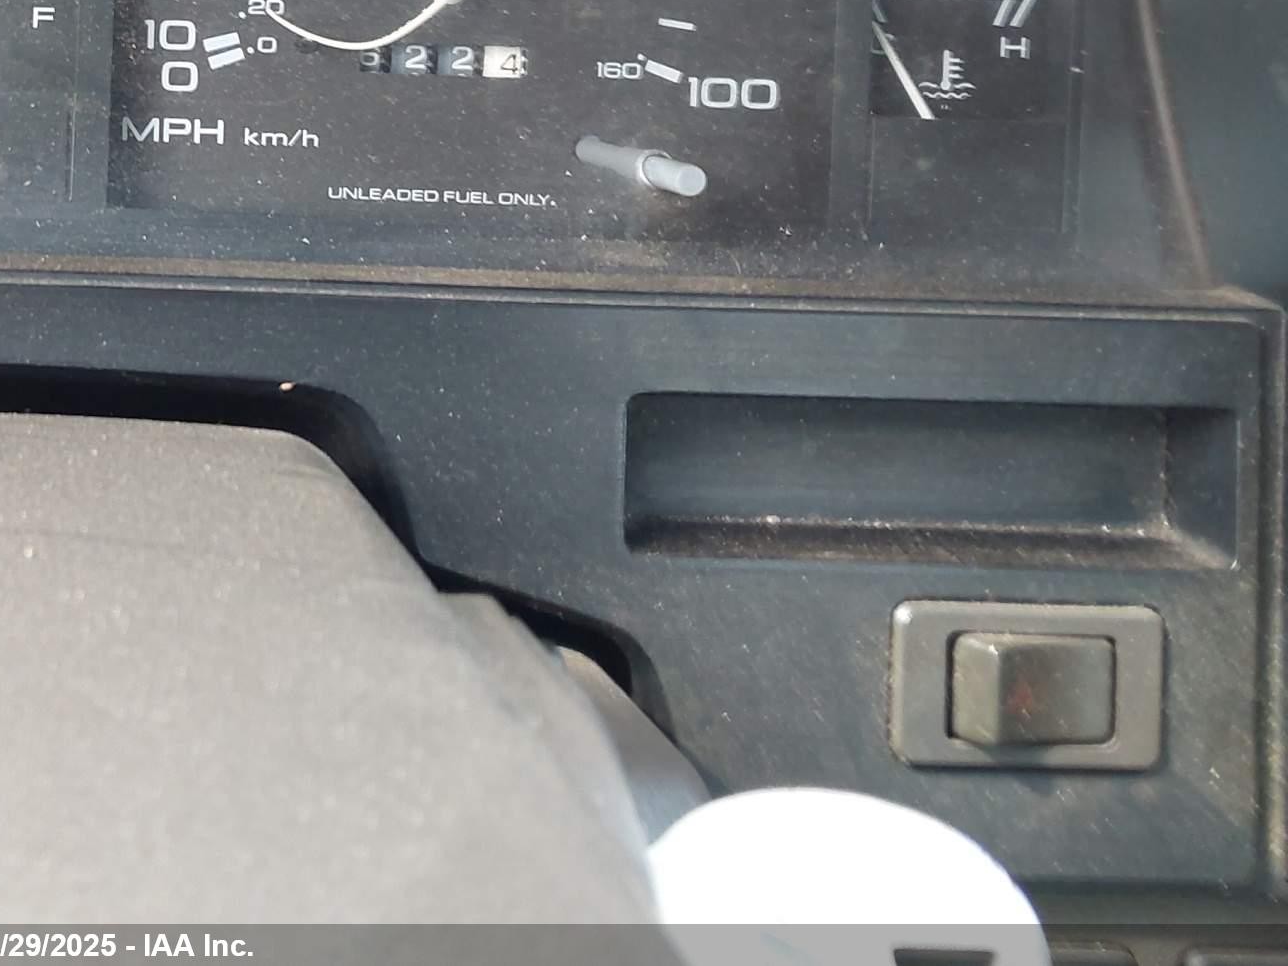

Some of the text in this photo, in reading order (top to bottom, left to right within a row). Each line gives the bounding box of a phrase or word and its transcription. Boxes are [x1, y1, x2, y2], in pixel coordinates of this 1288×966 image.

[32, 7, 55, 29] F
[144, 19, 197, 51] 10
[257, 36, 277, 54] 0
[999, 37, 1031, 60] H
[161, 60, 199, 92] 0
[596, 60, 644, 80] 160
[688, 76, 780, 110] 100
[121, 116, 320, 148] MPH km/h
[328, 186, 440, 203] UNLEADED
[444, 190, 494, 205] FUEL
